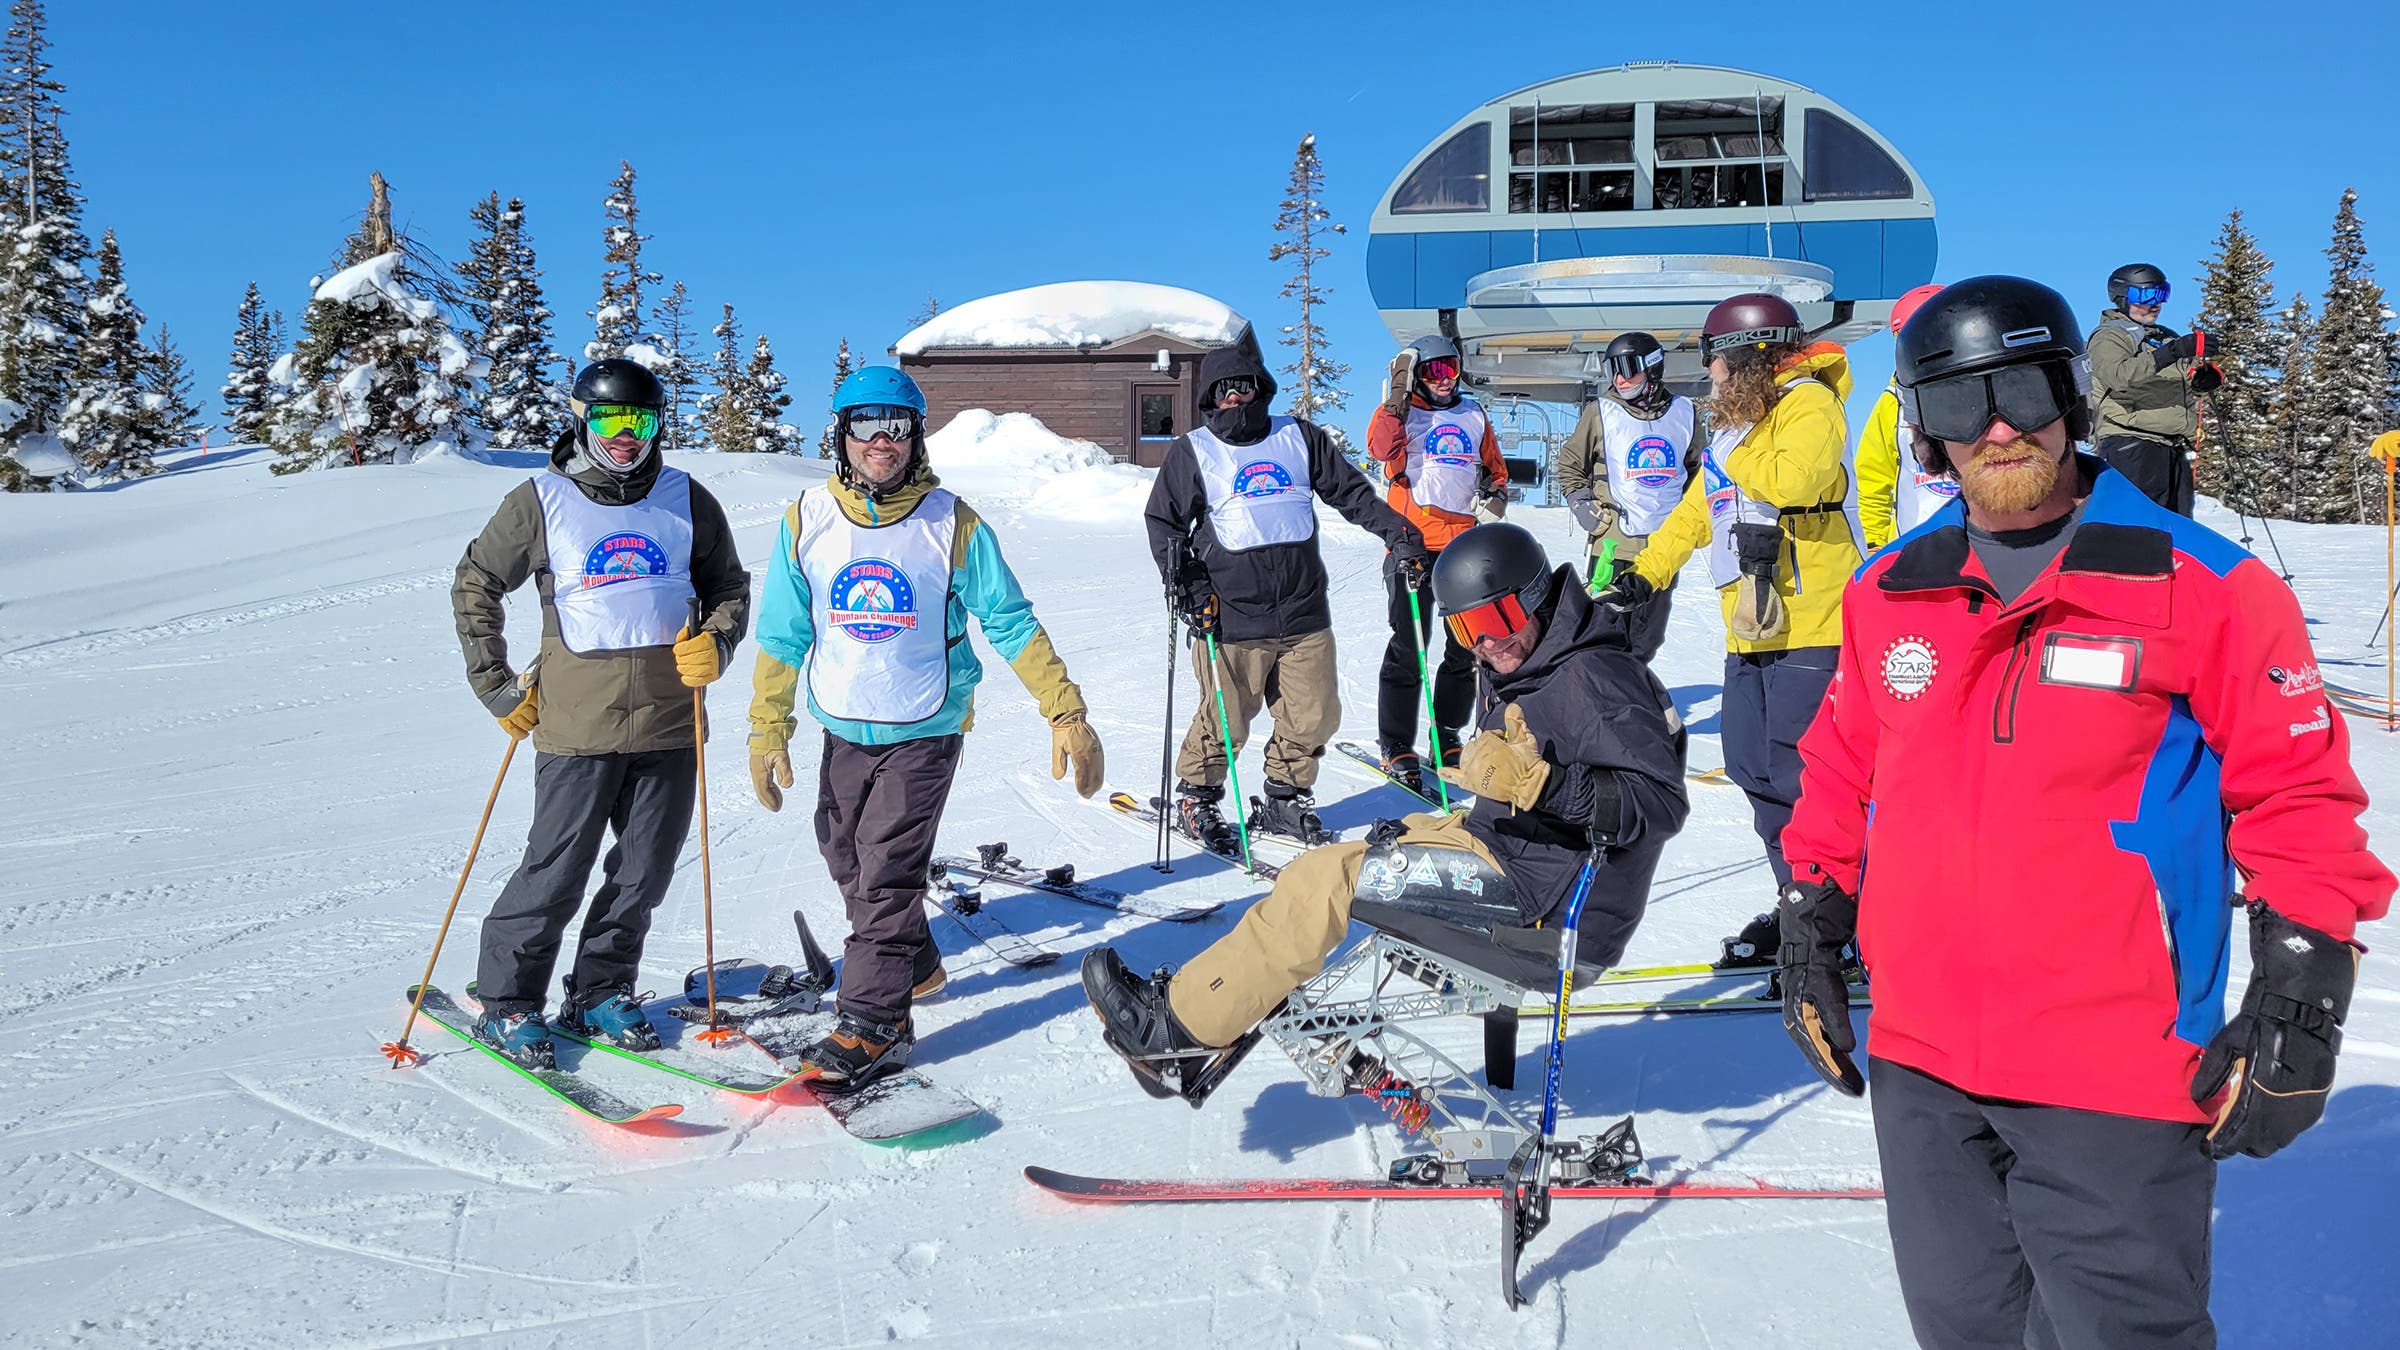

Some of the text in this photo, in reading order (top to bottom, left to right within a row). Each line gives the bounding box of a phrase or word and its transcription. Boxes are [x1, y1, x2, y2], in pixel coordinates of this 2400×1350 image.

[604, 536, 647, 552] STARS
[850, 564, 893, 579] STARS
[829, 611, 916, 630] Mountain Challenge
[1887, 658, 1931, 674] STARS
[1481, 764, 1496, 790] KINCO
[1560, 972, 1572, 1038] SUPERLITE
